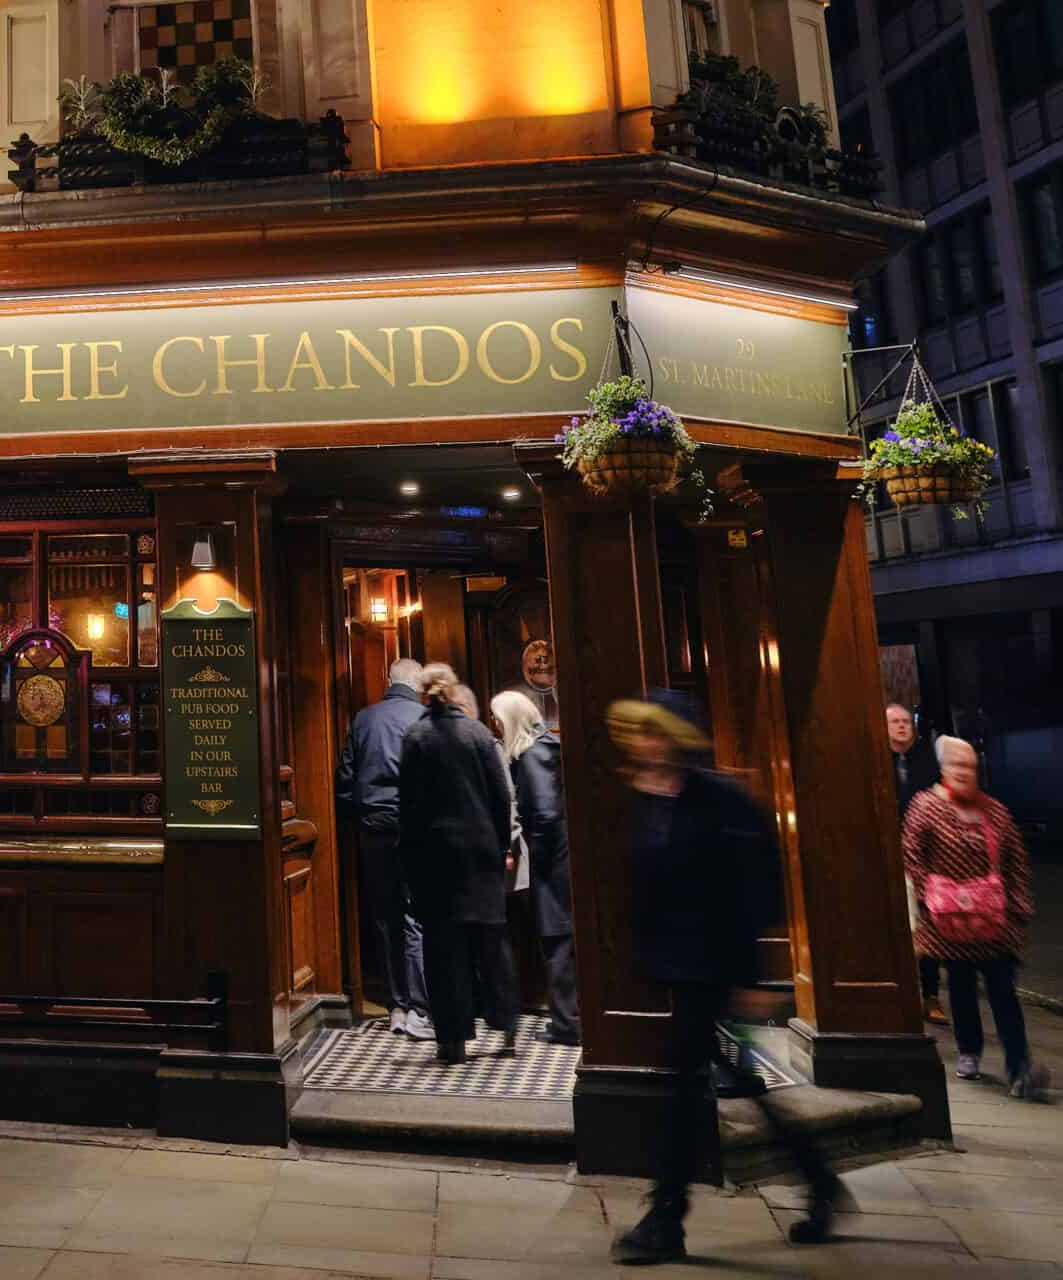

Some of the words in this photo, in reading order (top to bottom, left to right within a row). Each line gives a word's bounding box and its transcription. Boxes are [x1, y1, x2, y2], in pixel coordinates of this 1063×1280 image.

[152, 317, 588, 397] CHANDOS
[192, 628, 224, 642] THE
[172, 644, 246, 658] CHANDOS
[170, 687, 249, 699] TRADITIONAL
[181, 703, 204, 714] PUB
[205, 703, 239, 714] FOOD
[189, 719, 232, 730] SERVED
[194, 735, 227, 745] DAILY
[190, 751, 204, 761] IN
[206, 751, 232, 761] OUR
[186, 766, 238, 777] UPSTAIRS
[200, 782, 223, 793] BAR
